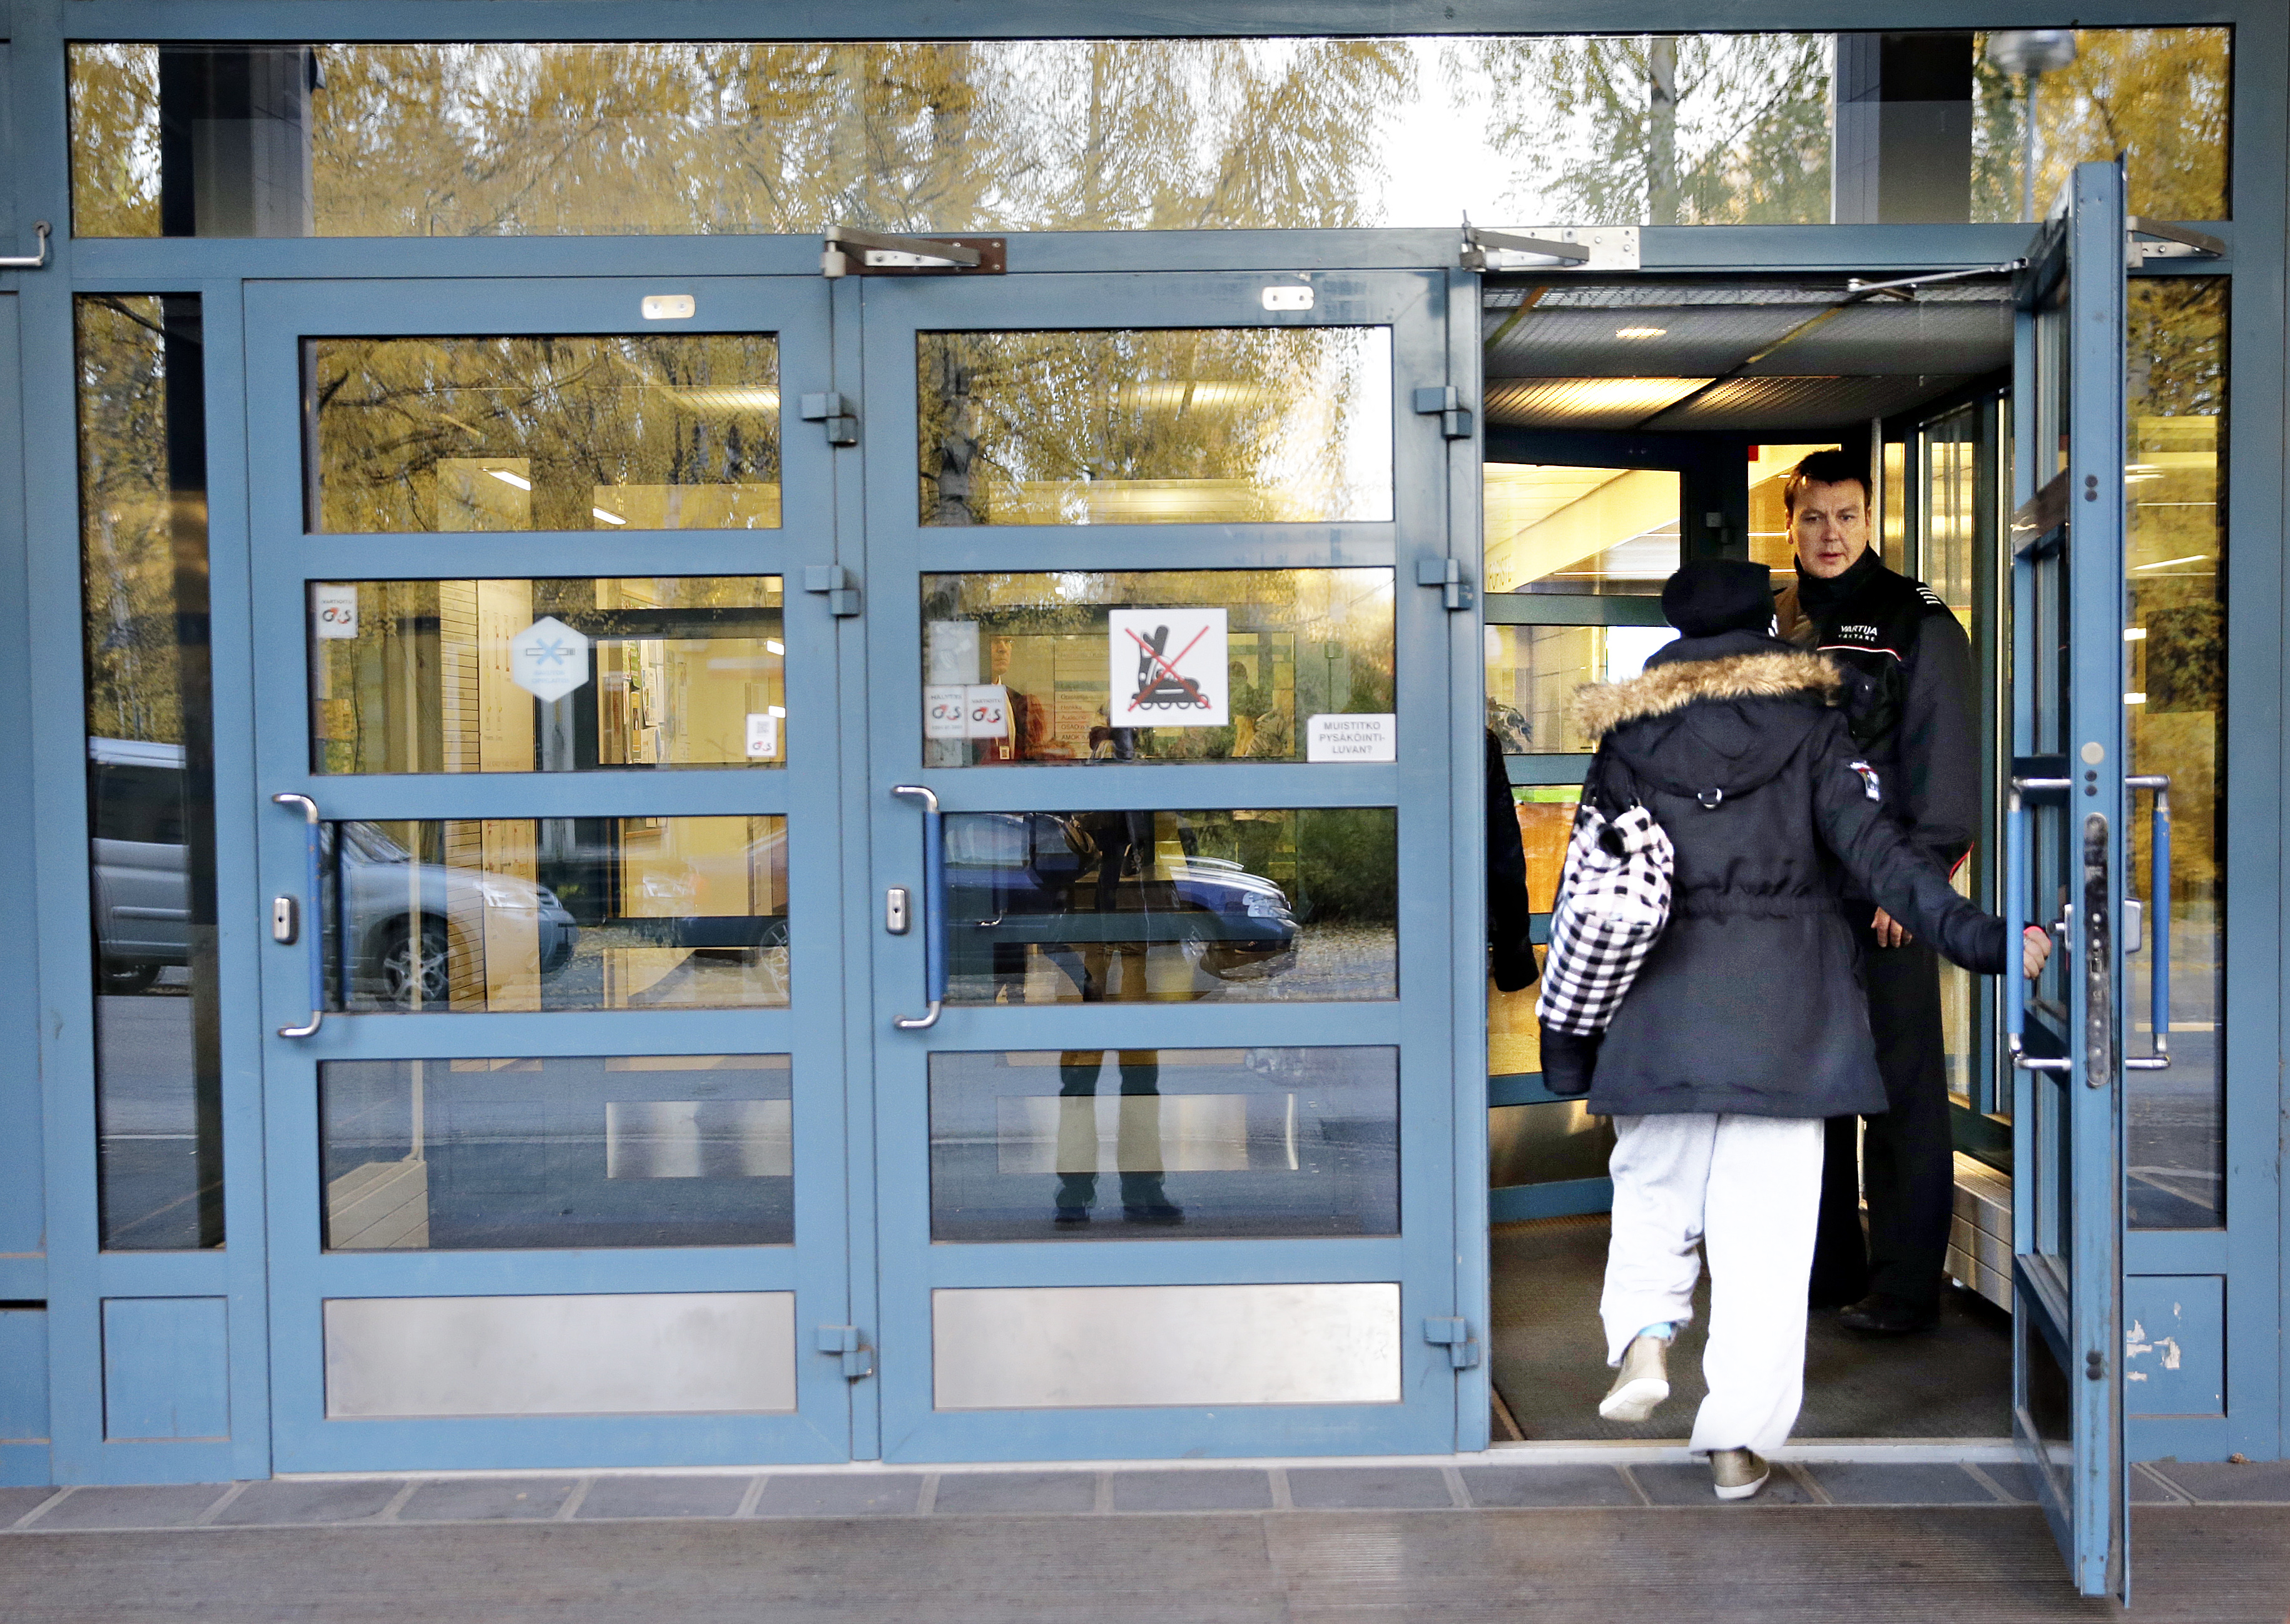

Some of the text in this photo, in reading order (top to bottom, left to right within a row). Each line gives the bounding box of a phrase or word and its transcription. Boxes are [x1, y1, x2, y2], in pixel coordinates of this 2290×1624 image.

[1841, 625, 1877, 636] VARTIJA
[1324, 721, 1380, 730] MUISTITKO
[1319, 732, 1385, 742] PYSÄKÖINTI-
[1333, 745, 1373, 754] LUVAN?
